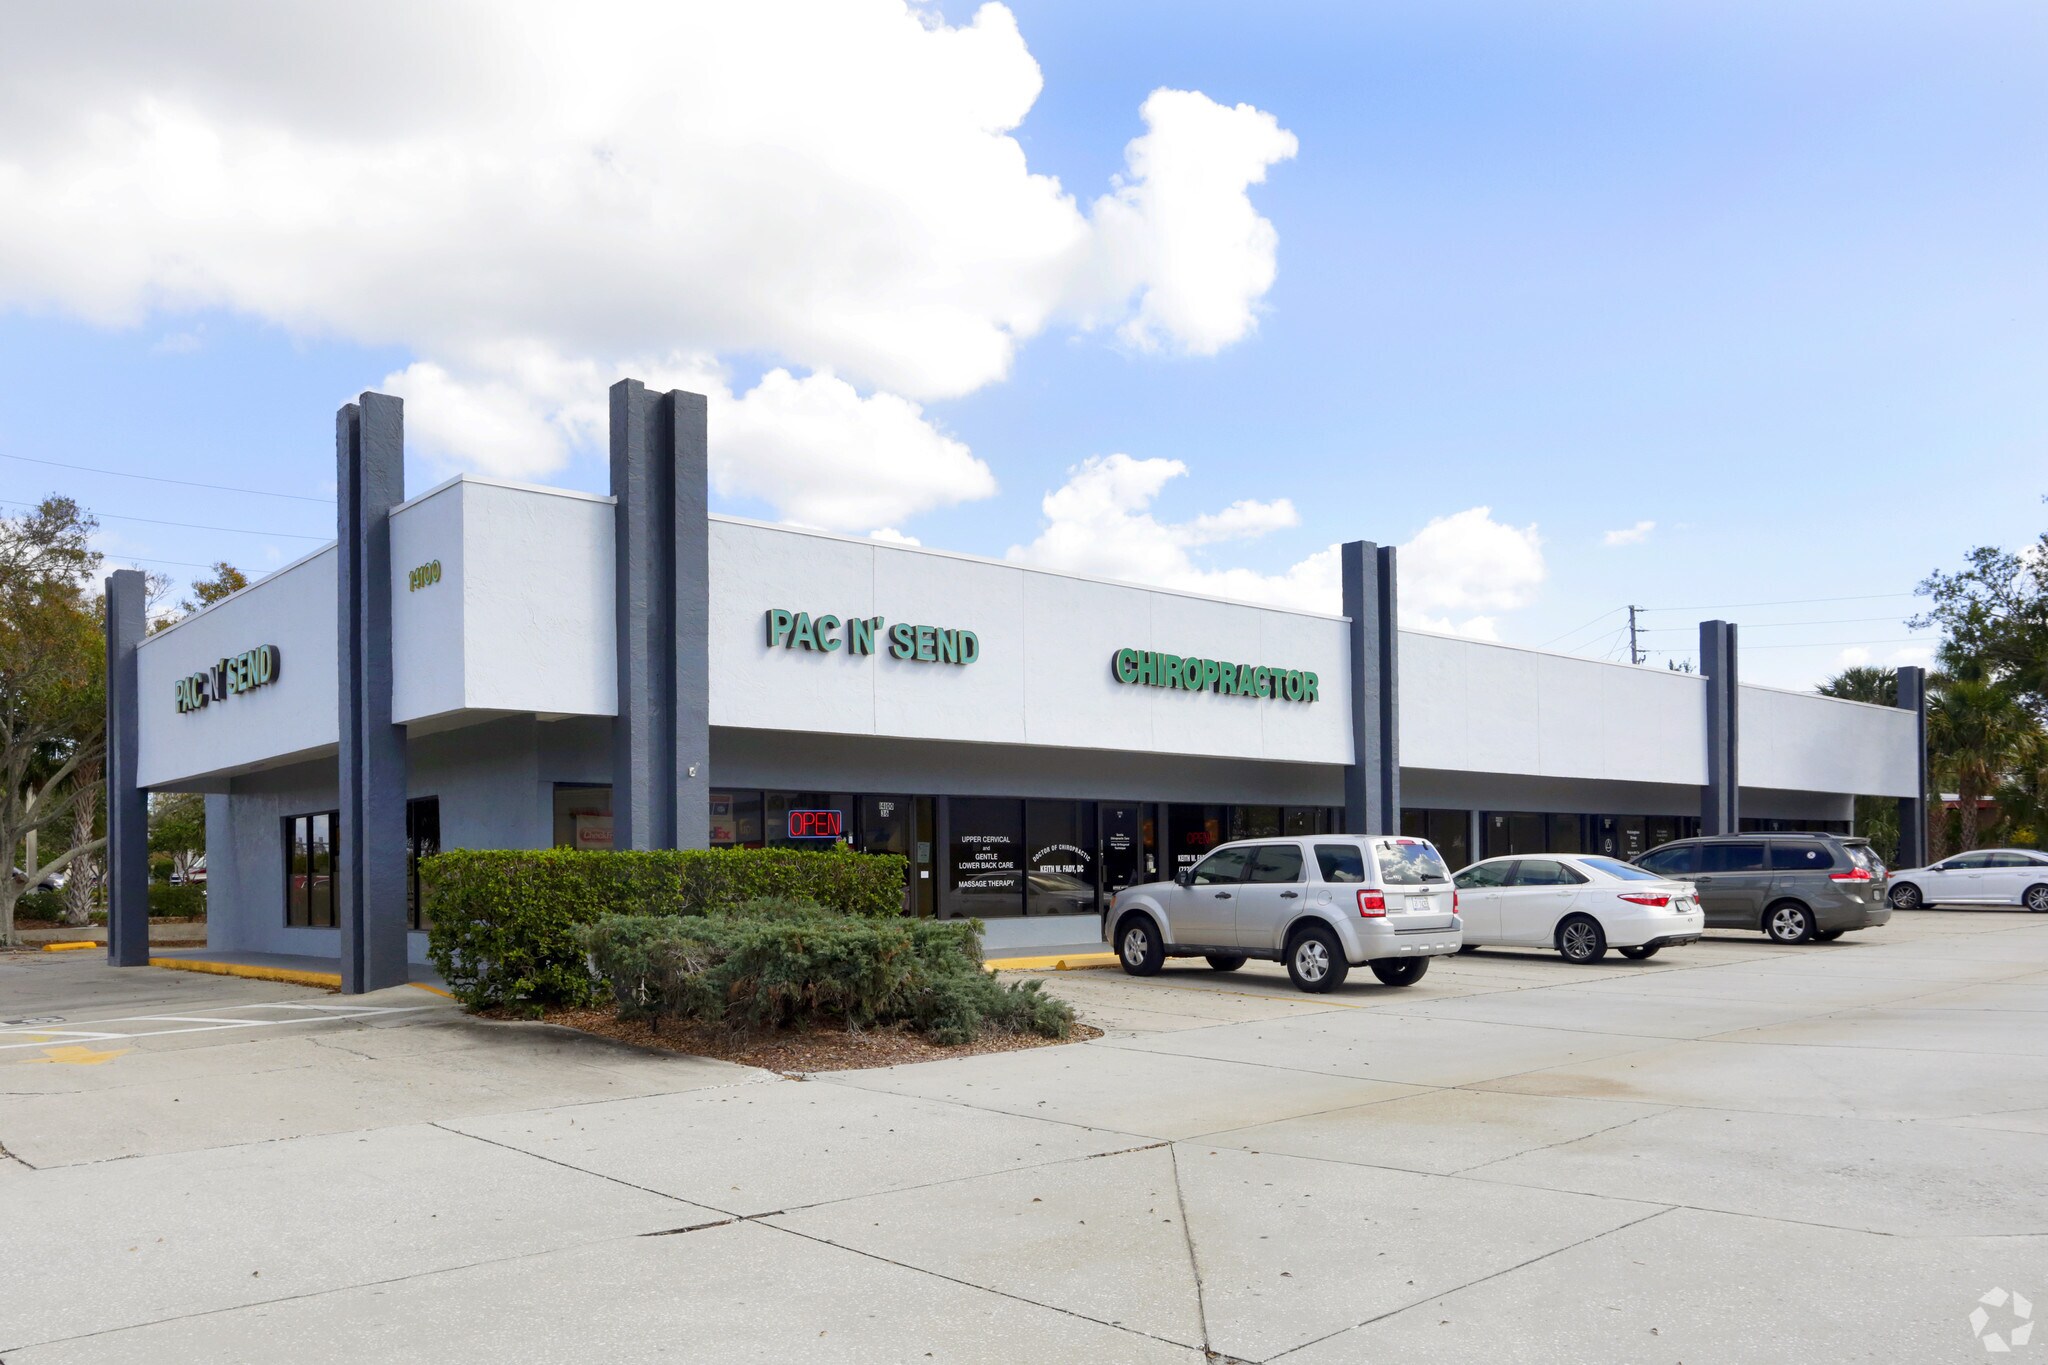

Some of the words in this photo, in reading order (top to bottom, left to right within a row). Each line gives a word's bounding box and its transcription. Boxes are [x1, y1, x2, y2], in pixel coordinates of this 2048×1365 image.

[765, 608, 842, 652] PAC
[847, 615, 885, 655] N'
[888, 622, 979, 665] SEND
[175, 671, 210, 714] PAC
[209, 658, 228, 701] N'
[226, 644, 281, 695] SEND
[1111, 648, 1320, 703] CHIROPRACTOR
[790, 811, 841, 836] OPEN
[961, 835, 982, 843] UPPER
[982, 835, 1011, 843] CERVICAL
[1186, 831, 1211, 845] OPEN
[974, 853, 998, 861] GENTLE
[1032, 846, 1051, 862] DOCTOR
[1050, 844, 1058, 852] OF
[1058, 844, 1091, 862] CHIROPRACTIC
[1177, 854, 1191, 862] KEITH
[958, 861, 981, 870] LOWER
[980, 861, 998, 869] BACK
[997, 861, 1014, 869] CARE
[1039, 864, 1055, 873] KEITH
[1055, 864, 1062, 872] W.
[1062, 864, 1077, 874] FADY,
[1076, 864, 1085, 873] DC
[958, 880, 988, 888] MASSAGE
[987, 879, 1015, 887] THERAPY
